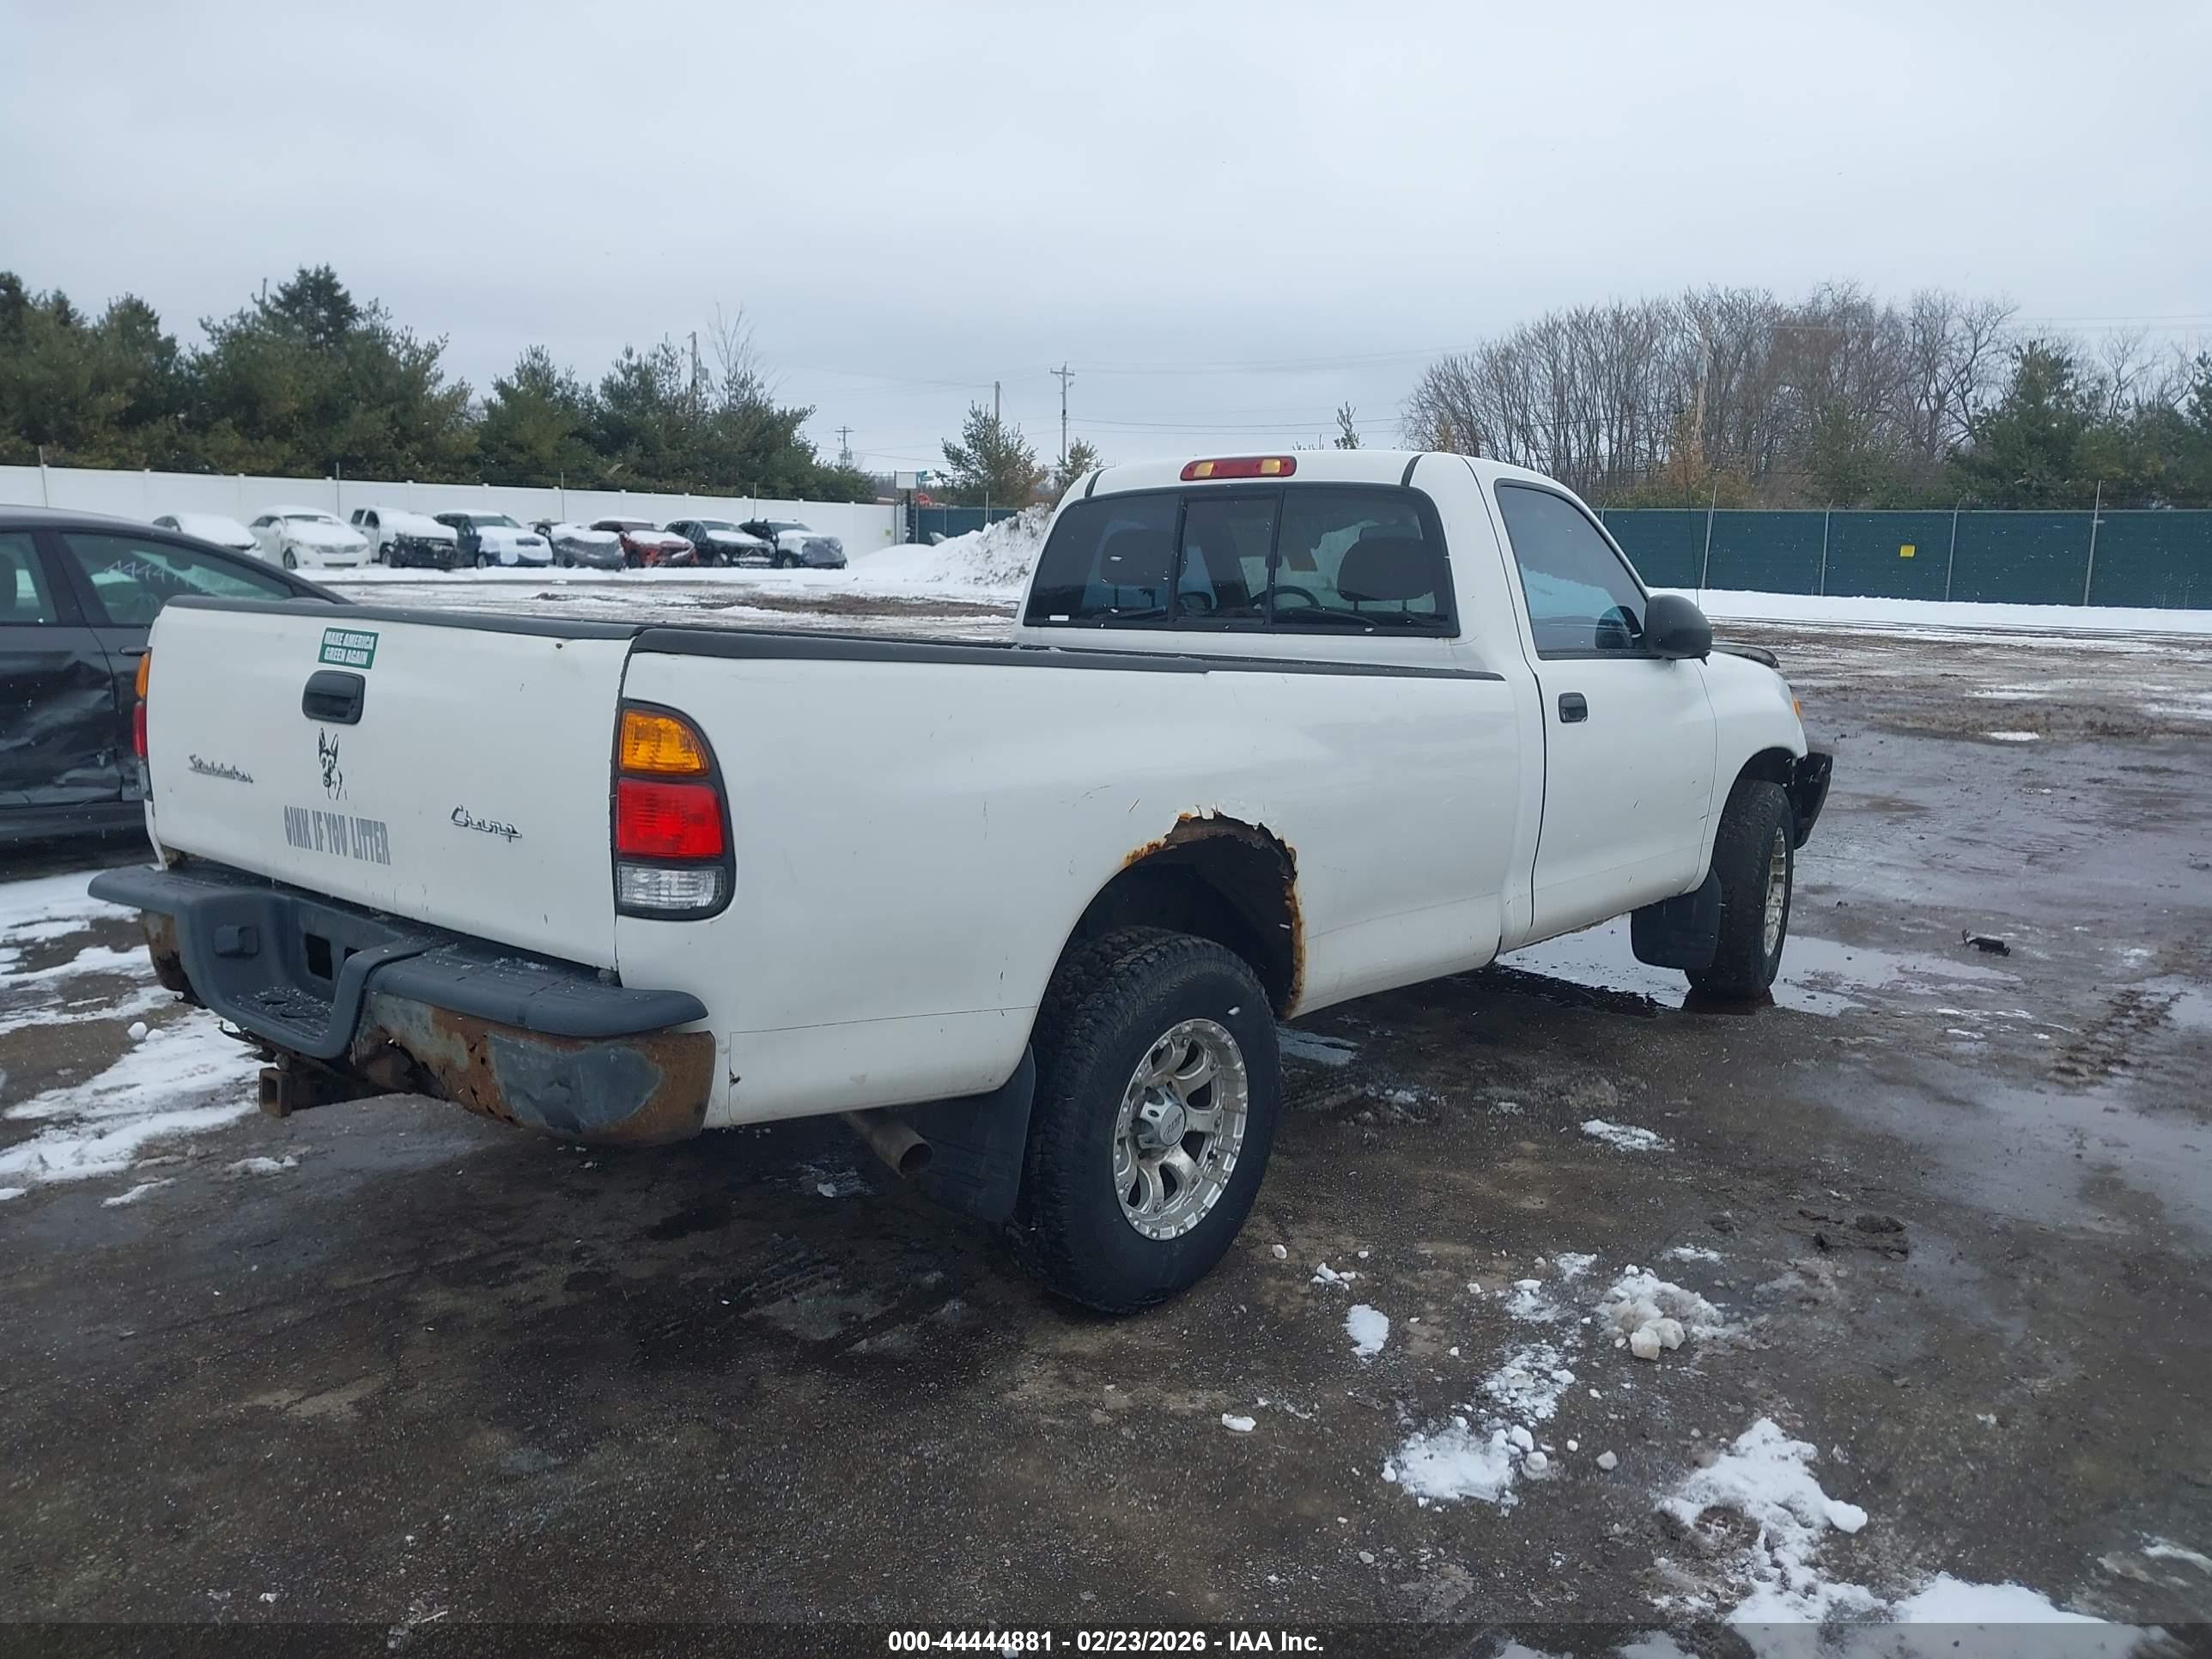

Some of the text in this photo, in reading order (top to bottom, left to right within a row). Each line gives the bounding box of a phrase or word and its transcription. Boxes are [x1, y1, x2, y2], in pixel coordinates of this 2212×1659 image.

[324, 630, 375, 650] MAKE AMERICA
[324, 647, 368, 665] GREEN AGAIN
[283, 805, 391, 866] OINK IF YOU LITTER
[451, 805, 522, 843] Champ
